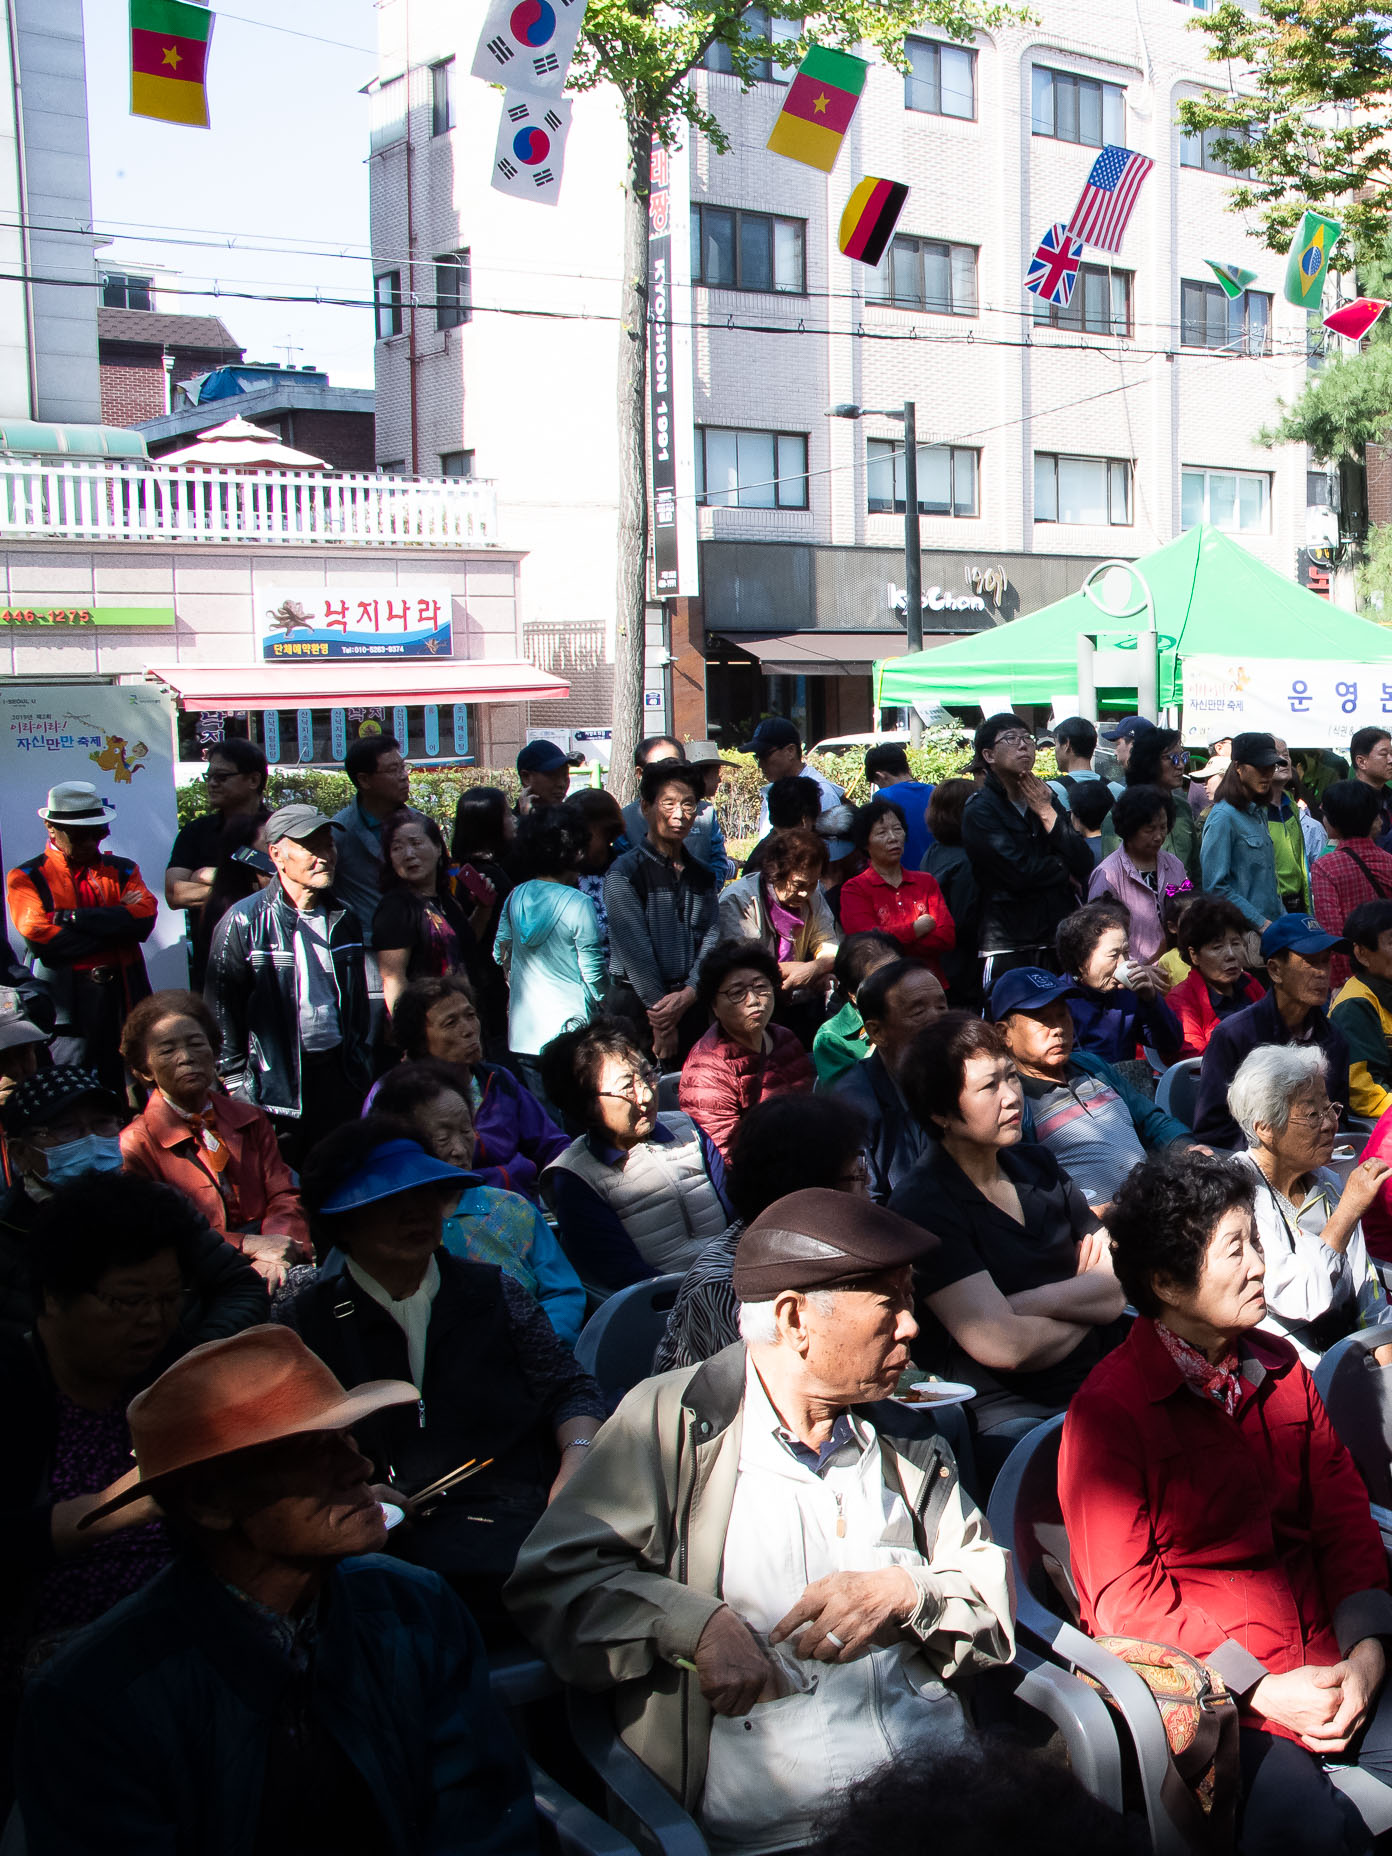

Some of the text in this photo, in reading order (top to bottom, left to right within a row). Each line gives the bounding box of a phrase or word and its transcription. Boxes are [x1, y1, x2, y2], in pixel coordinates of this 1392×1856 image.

[650, 131, 670, 232] 래짱
[654, 258, 670, 462] KYOCHON 1991
[1, 609, 90, 623] 446-1275
[324, 598, 442, 635] 낙지나라
[1190, 699, 1225, 712] 자신만만
[16, 735, 75, 751] 자신만만
